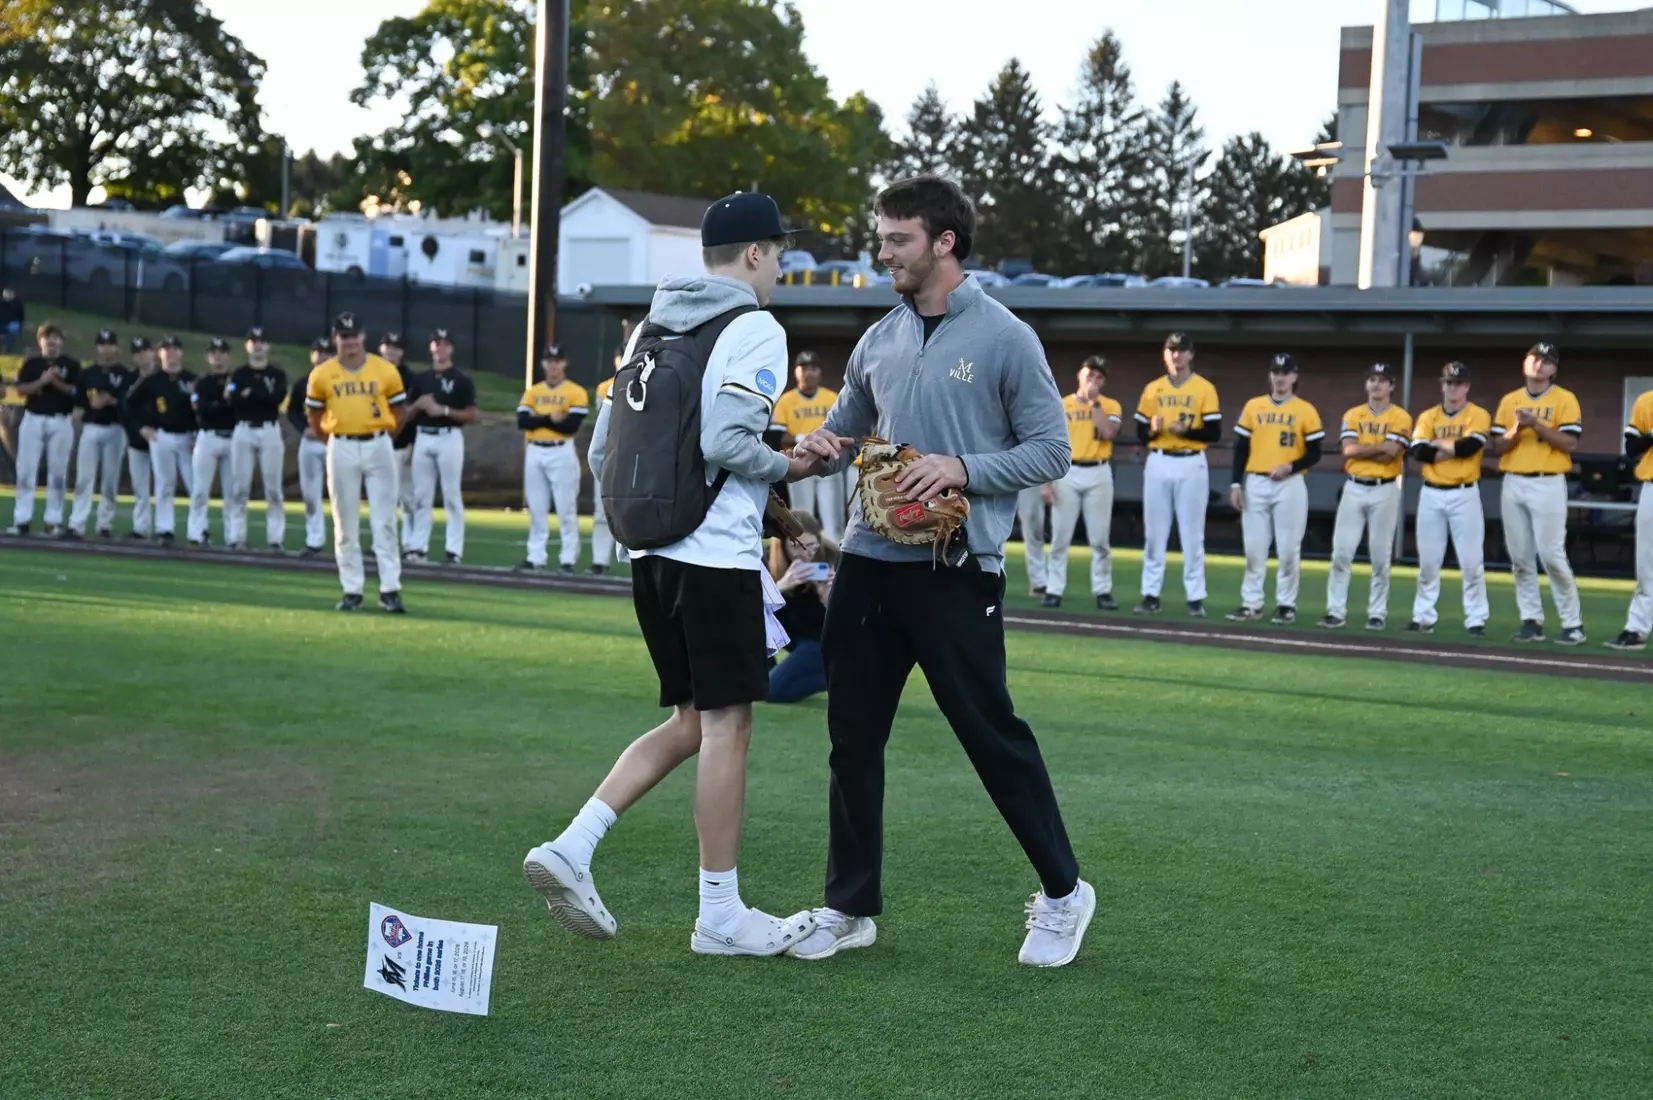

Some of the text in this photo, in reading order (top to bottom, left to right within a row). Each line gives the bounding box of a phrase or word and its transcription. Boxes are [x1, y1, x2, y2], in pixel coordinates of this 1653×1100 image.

[950, 368, 974, 384] VILLE
[333, 381, 378, 398] VILLE
[1158, 394, 1195, 408] VILLE
[1257, 412, 1296, 426] VILLE
[423, 966, 431, 987] Phillies
